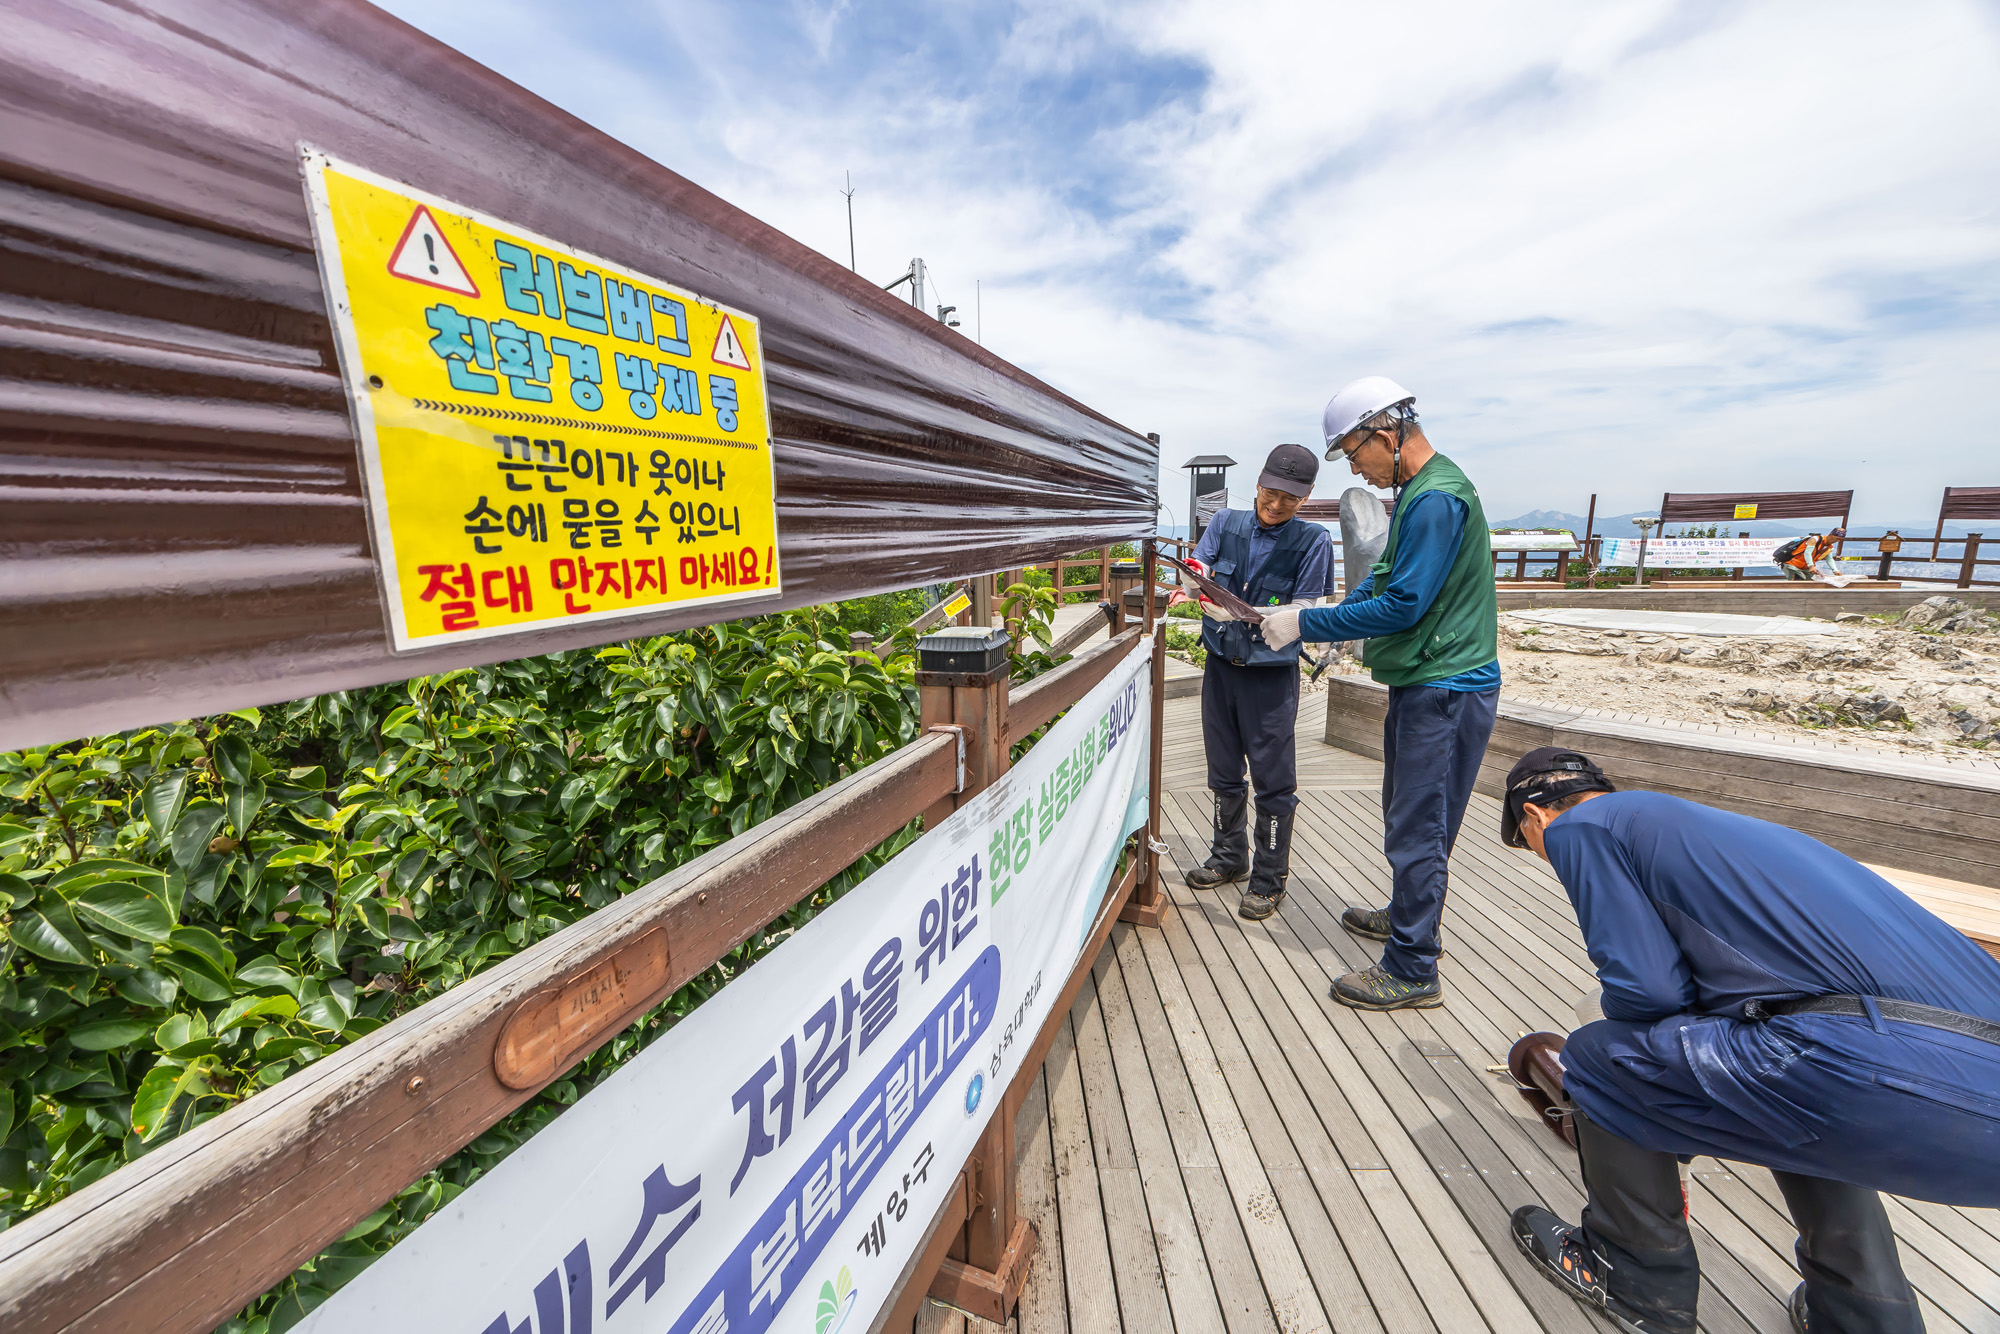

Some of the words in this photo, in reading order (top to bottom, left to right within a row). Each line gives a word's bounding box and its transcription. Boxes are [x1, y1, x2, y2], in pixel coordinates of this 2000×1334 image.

[494, 239, 691, 358] 러브버그
[425, 303, 603, 412] 친환경
[614, 352, 702, 420] 방제
[708, 373, 740, 432] 중
[493, 434, 639, 491] 끈끈이가
[648, 449, 726, 496] 옷이나
[1279, 457, 1298, 476] LA
[464, 495, 548, 554] 손에
[562, 498, 623, 549] 묻을
[634, 500, 660, 545] 수
[669, 500, 741, 544] 있으니
[418, 558, 533, 632] 절대
[550, 555, 667, 614] 만지지
[680, 546, 774, 589] 마세요!
[730, 936, 903, 1198] 저감을
[914, 853, 982, 984] 위한
[989, 798, 1034, 907] 현장
[1038, 727, 1097, 847] 실증실험
[1097, 678, 1137, 766] 중입니다
[990, 970, 1042, 1079] 삼육대학교
[749, 983, 980, 1316] 부탁드립니다.
[856, 1141, 935, 1258] 계양구
